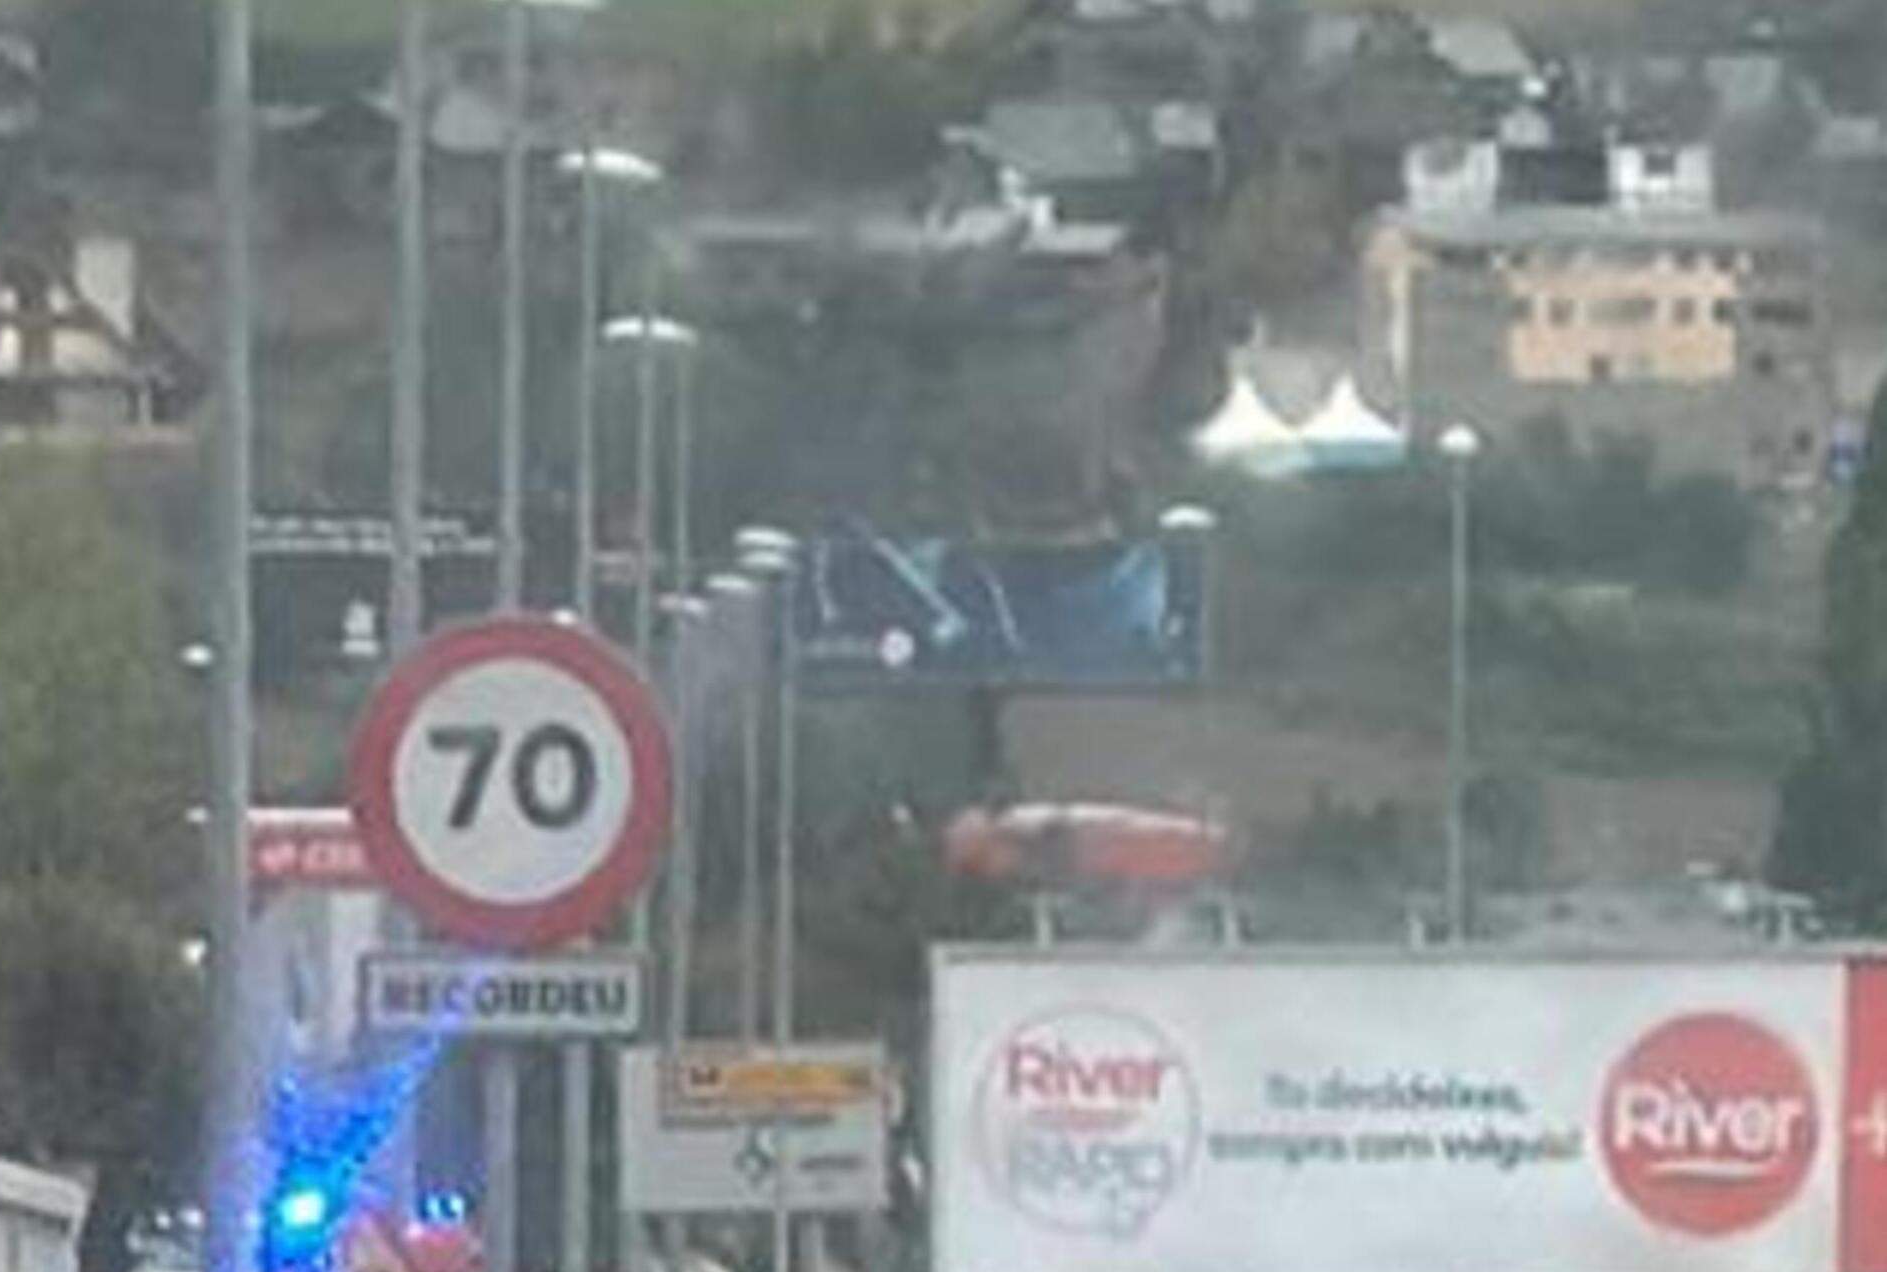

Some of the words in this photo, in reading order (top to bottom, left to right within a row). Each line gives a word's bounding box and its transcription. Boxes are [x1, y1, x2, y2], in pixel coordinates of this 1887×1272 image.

[428, 721, 598, 830] 70
[382, 976, 628, 1015] RECORDEU
[1006, 1042, 1164, 1102] River
[1614, 1076, 1804, 1153] River
